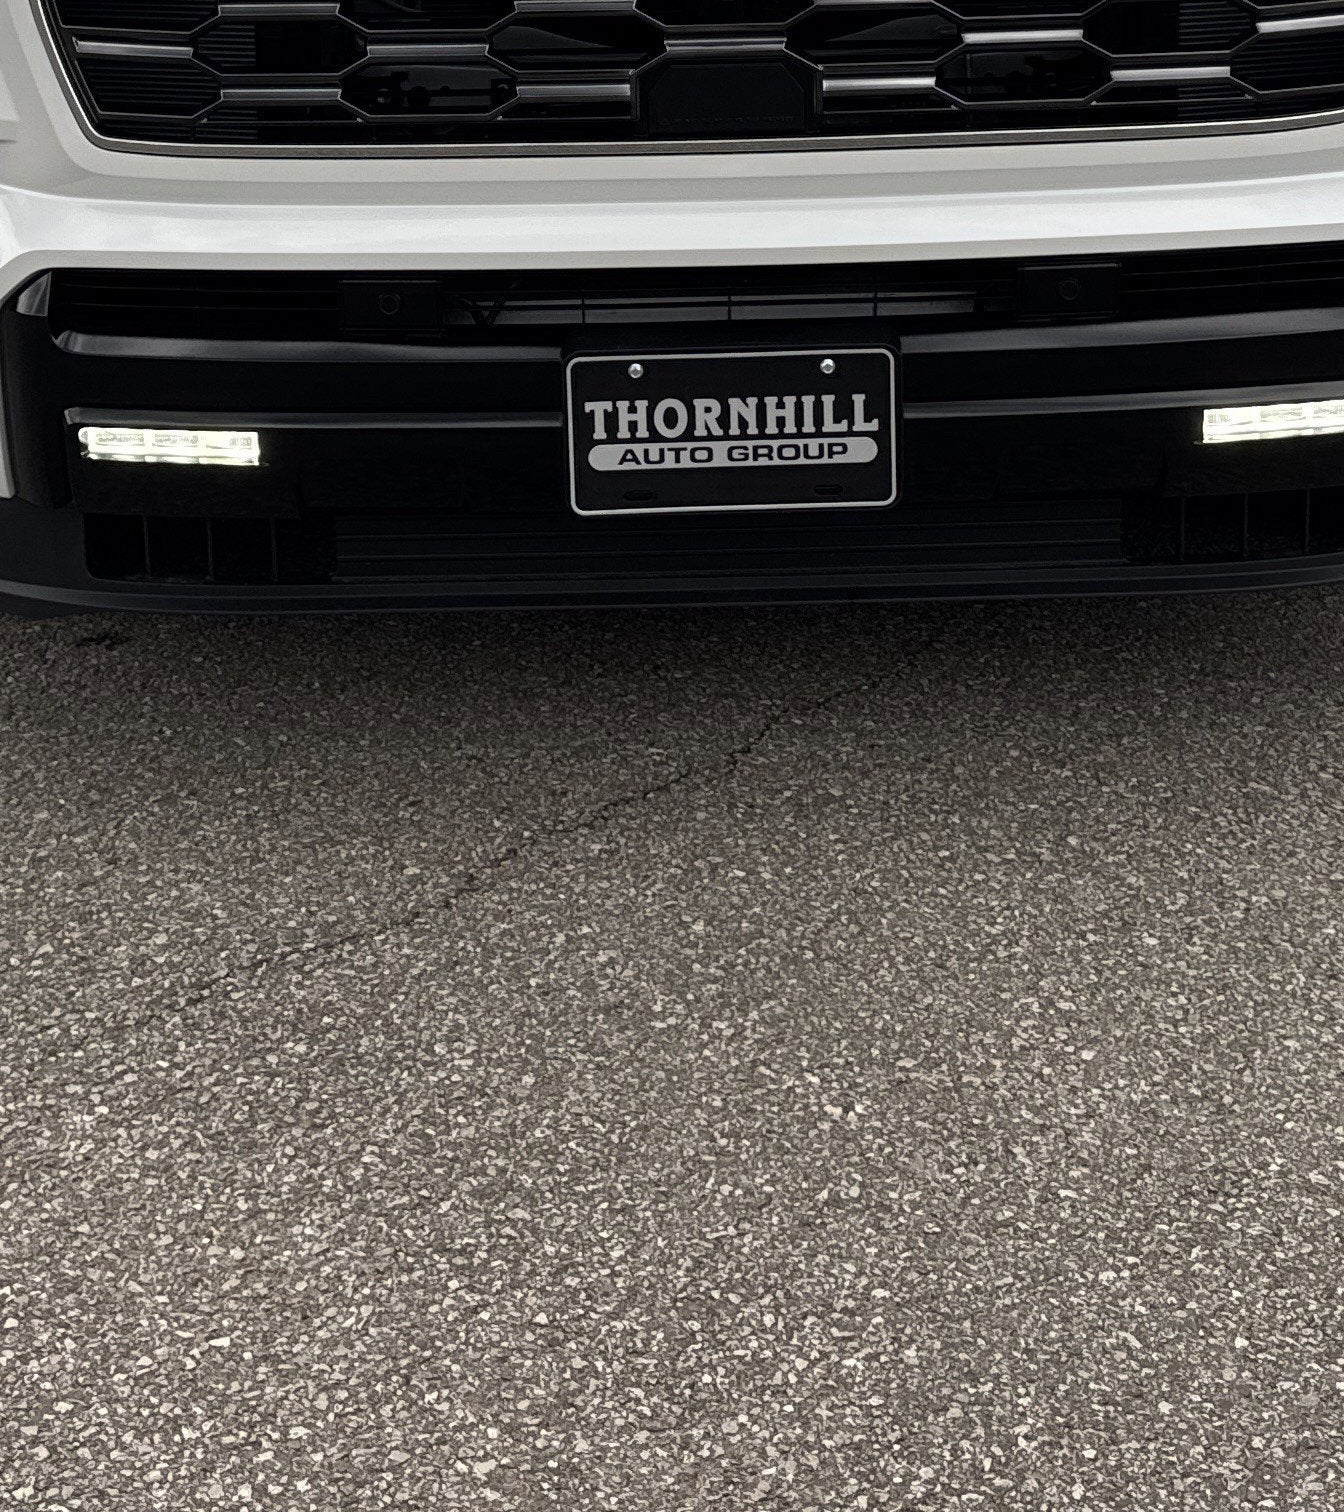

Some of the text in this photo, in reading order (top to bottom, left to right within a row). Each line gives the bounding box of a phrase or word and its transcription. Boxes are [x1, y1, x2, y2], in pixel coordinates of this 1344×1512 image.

[584, 393, 879, 439] THORNHILL
[617, 442, 848, 466] AUTO GROUP
